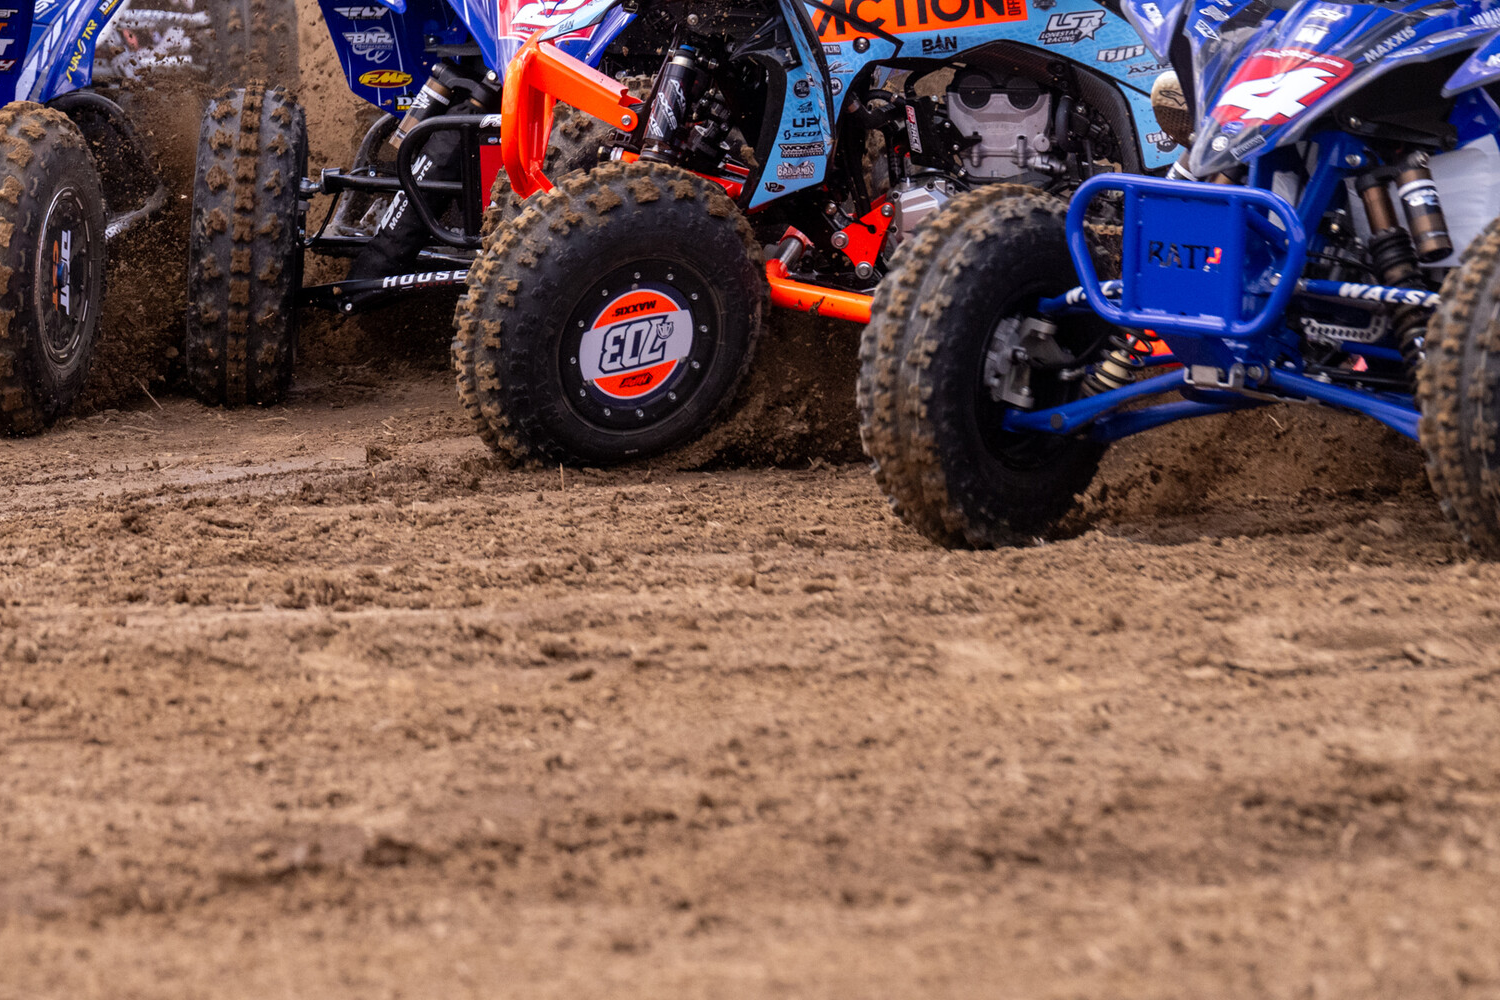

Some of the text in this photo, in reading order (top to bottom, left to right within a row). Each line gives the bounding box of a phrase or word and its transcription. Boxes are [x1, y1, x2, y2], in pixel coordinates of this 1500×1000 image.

[1046, 10, 1107, 31] LSR
[352, 33, 394, 44] BNR
[921, 34, 958, 53] BAN
[1040, 28, 1080, 40] LONESTAR
[1045, 36, 1077, 44] RACING
[1362, 24, 1417, 64] MAXXIS
[359, 73, 413, 87] FMF
[1216, 66, 1340, 121] 4
[381, 268, 469, 290] HOUSE
[612, 300, 657, 318] MAXXIS
[598, 314, 670, 375] 703
